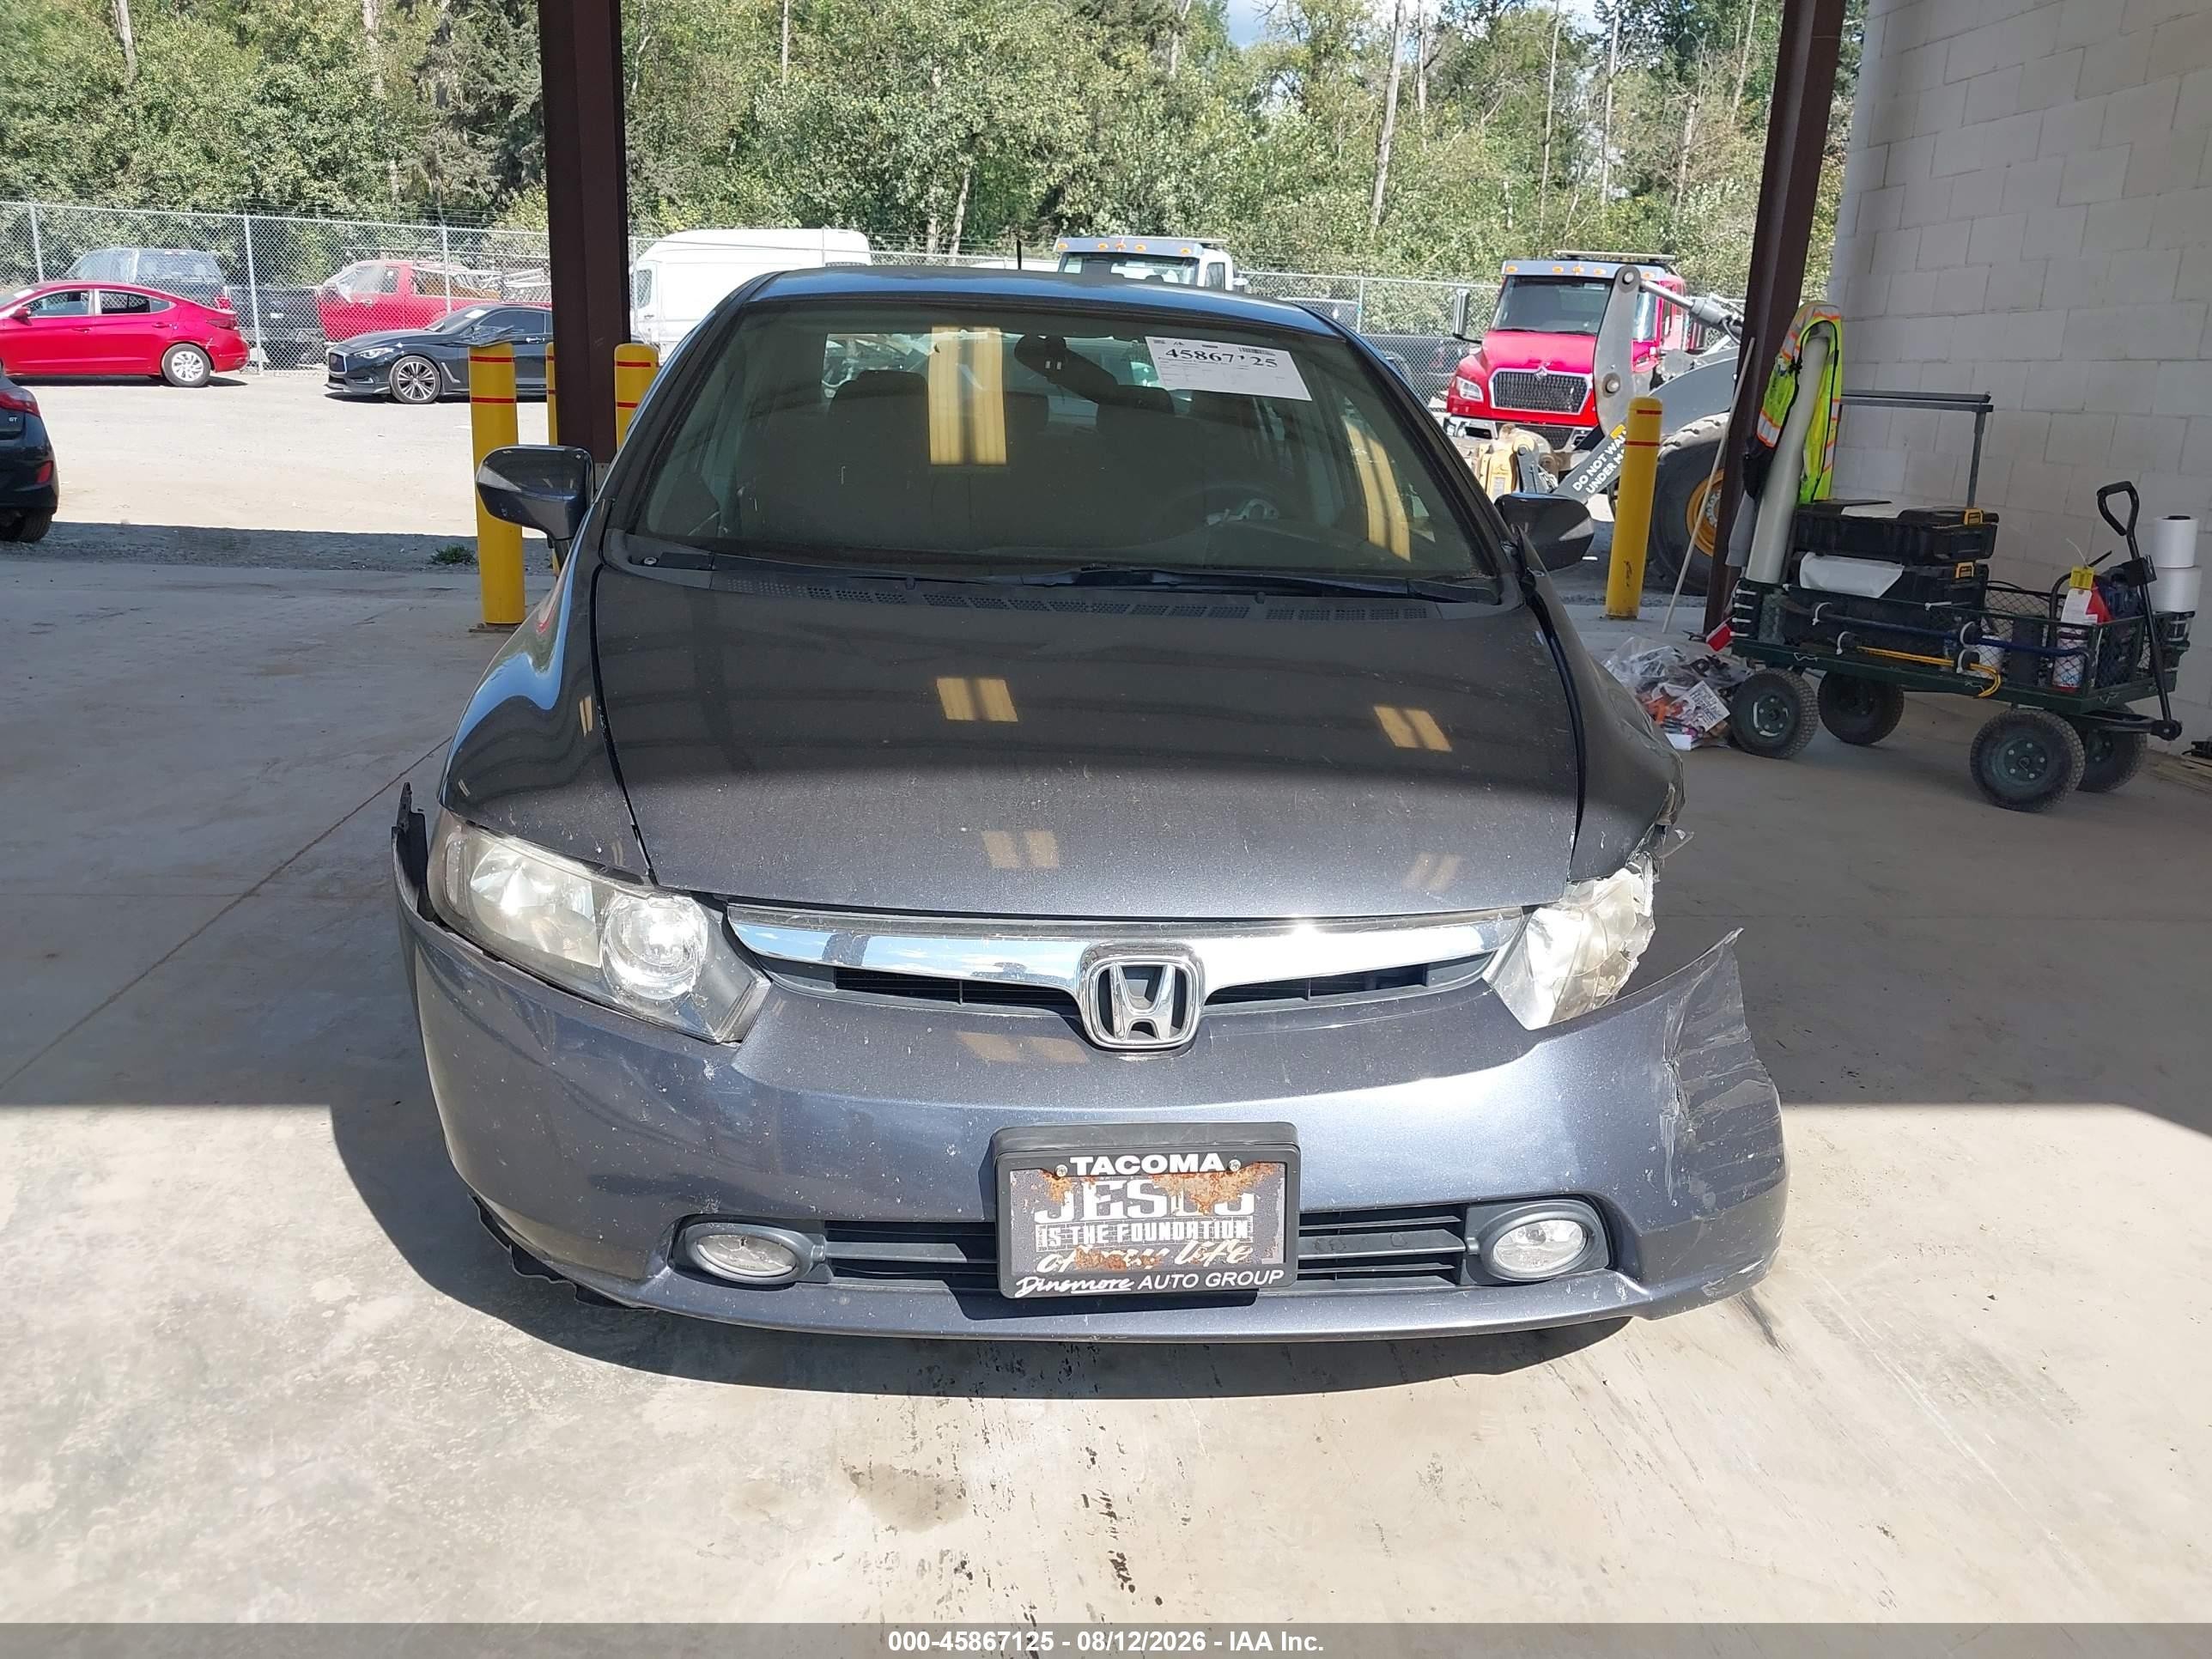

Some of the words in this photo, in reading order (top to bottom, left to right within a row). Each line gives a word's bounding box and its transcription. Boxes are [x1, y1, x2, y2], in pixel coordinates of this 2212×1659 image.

[1572, 474, 1589, 491] DO
[1586, 453, 1607, 476] NOT
[1585, 462, 1617, 494] UNDER
[1069, 1152, 1226, 1176] TACOMA
[1041, 1225, 1061, 1248] IS
[1069, 1224, 1110, 1246] THE
[1116, 1218, 1249, 1244] FOUNDATION
[1014, 1275, 1134, 1297] Dinsmore
[1137, 1273, 1200, 1291] AUTO
[1205, 1269, 1285, 1288] GROUP
